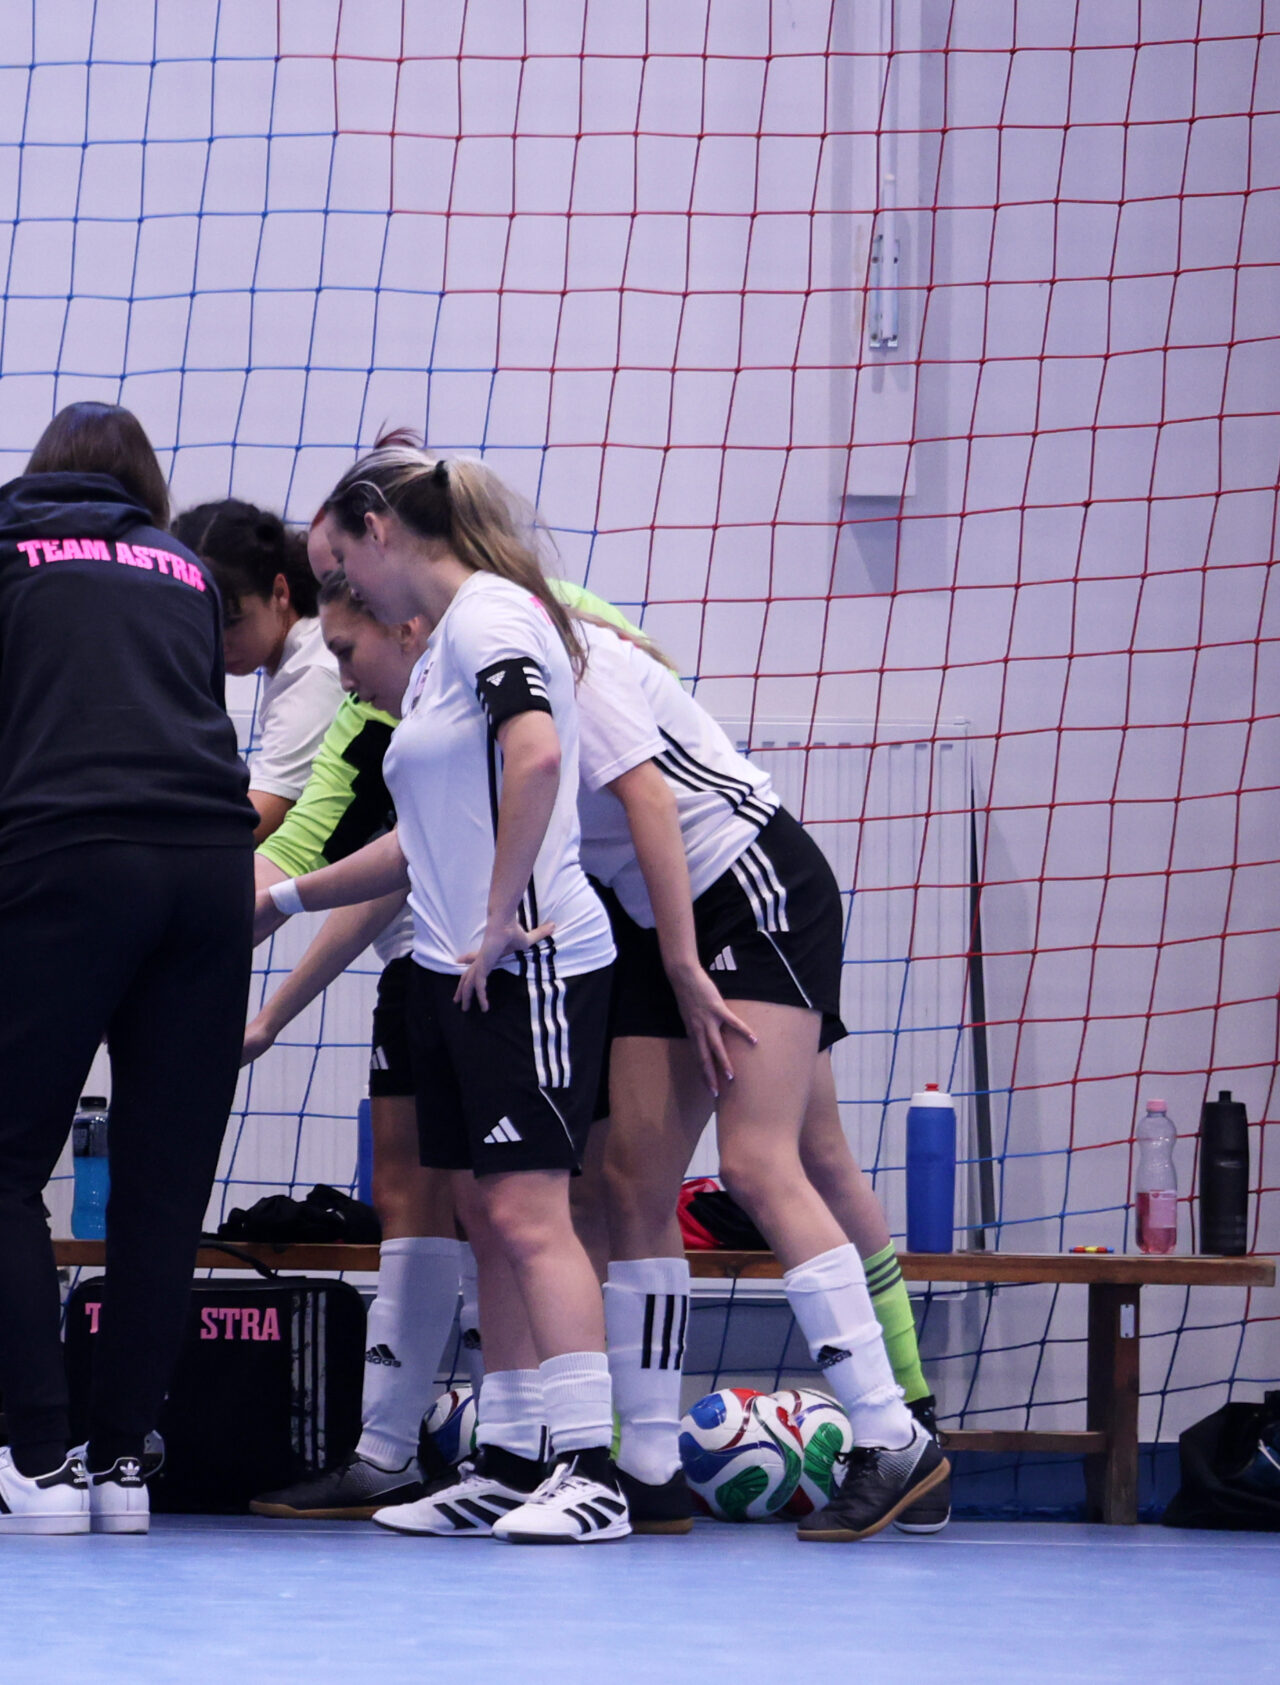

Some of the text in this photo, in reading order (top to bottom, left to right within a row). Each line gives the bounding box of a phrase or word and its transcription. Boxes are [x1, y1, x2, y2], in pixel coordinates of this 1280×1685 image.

[16, 538, 206, 592] TEAM ASTRA
[200, 1307, 280, 1340] STRA
